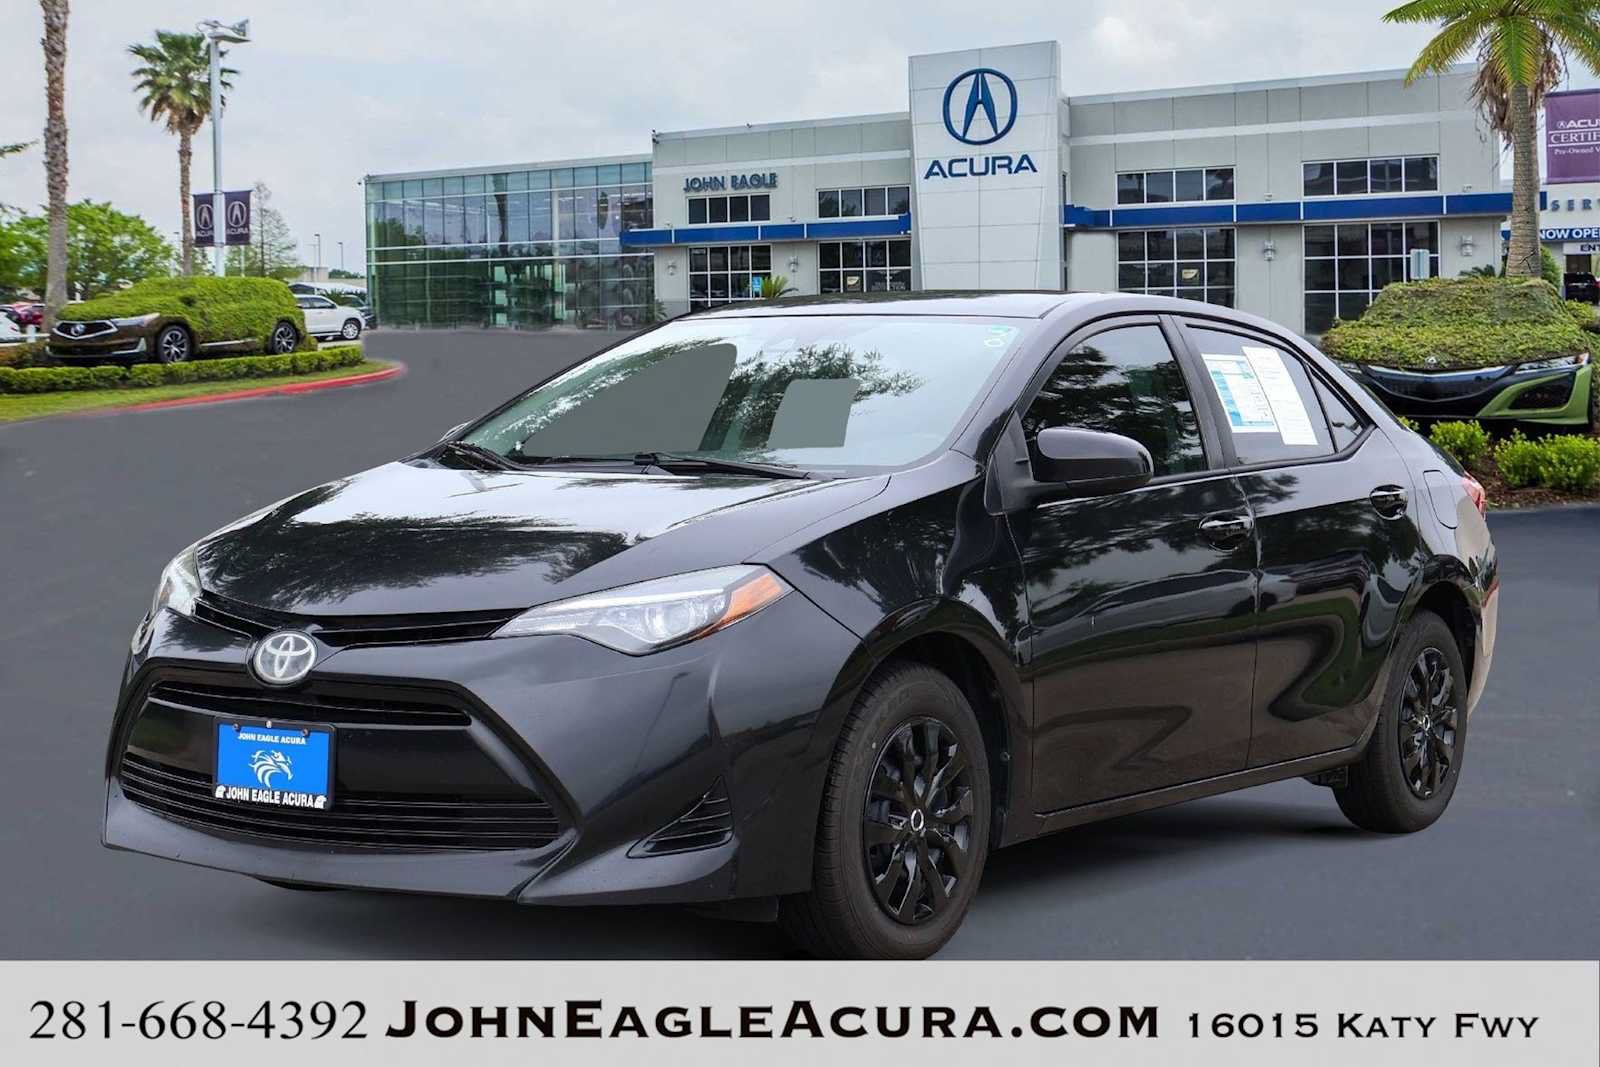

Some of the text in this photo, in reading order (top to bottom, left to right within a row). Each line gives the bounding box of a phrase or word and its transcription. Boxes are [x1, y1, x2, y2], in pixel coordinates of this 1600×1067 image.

[1567, 119, 1600, 128] ACU
[924, 154, 1038, 180] ACURA
[683, 172, 777, 192] JOHN EAGLE
[1540, 228, 1600, 239] NOW OPE
[238, 732, 306, 745] JOHN EAGLE ACURA
[226, 787, 314, 808] JOHN EAGLE ACURA
